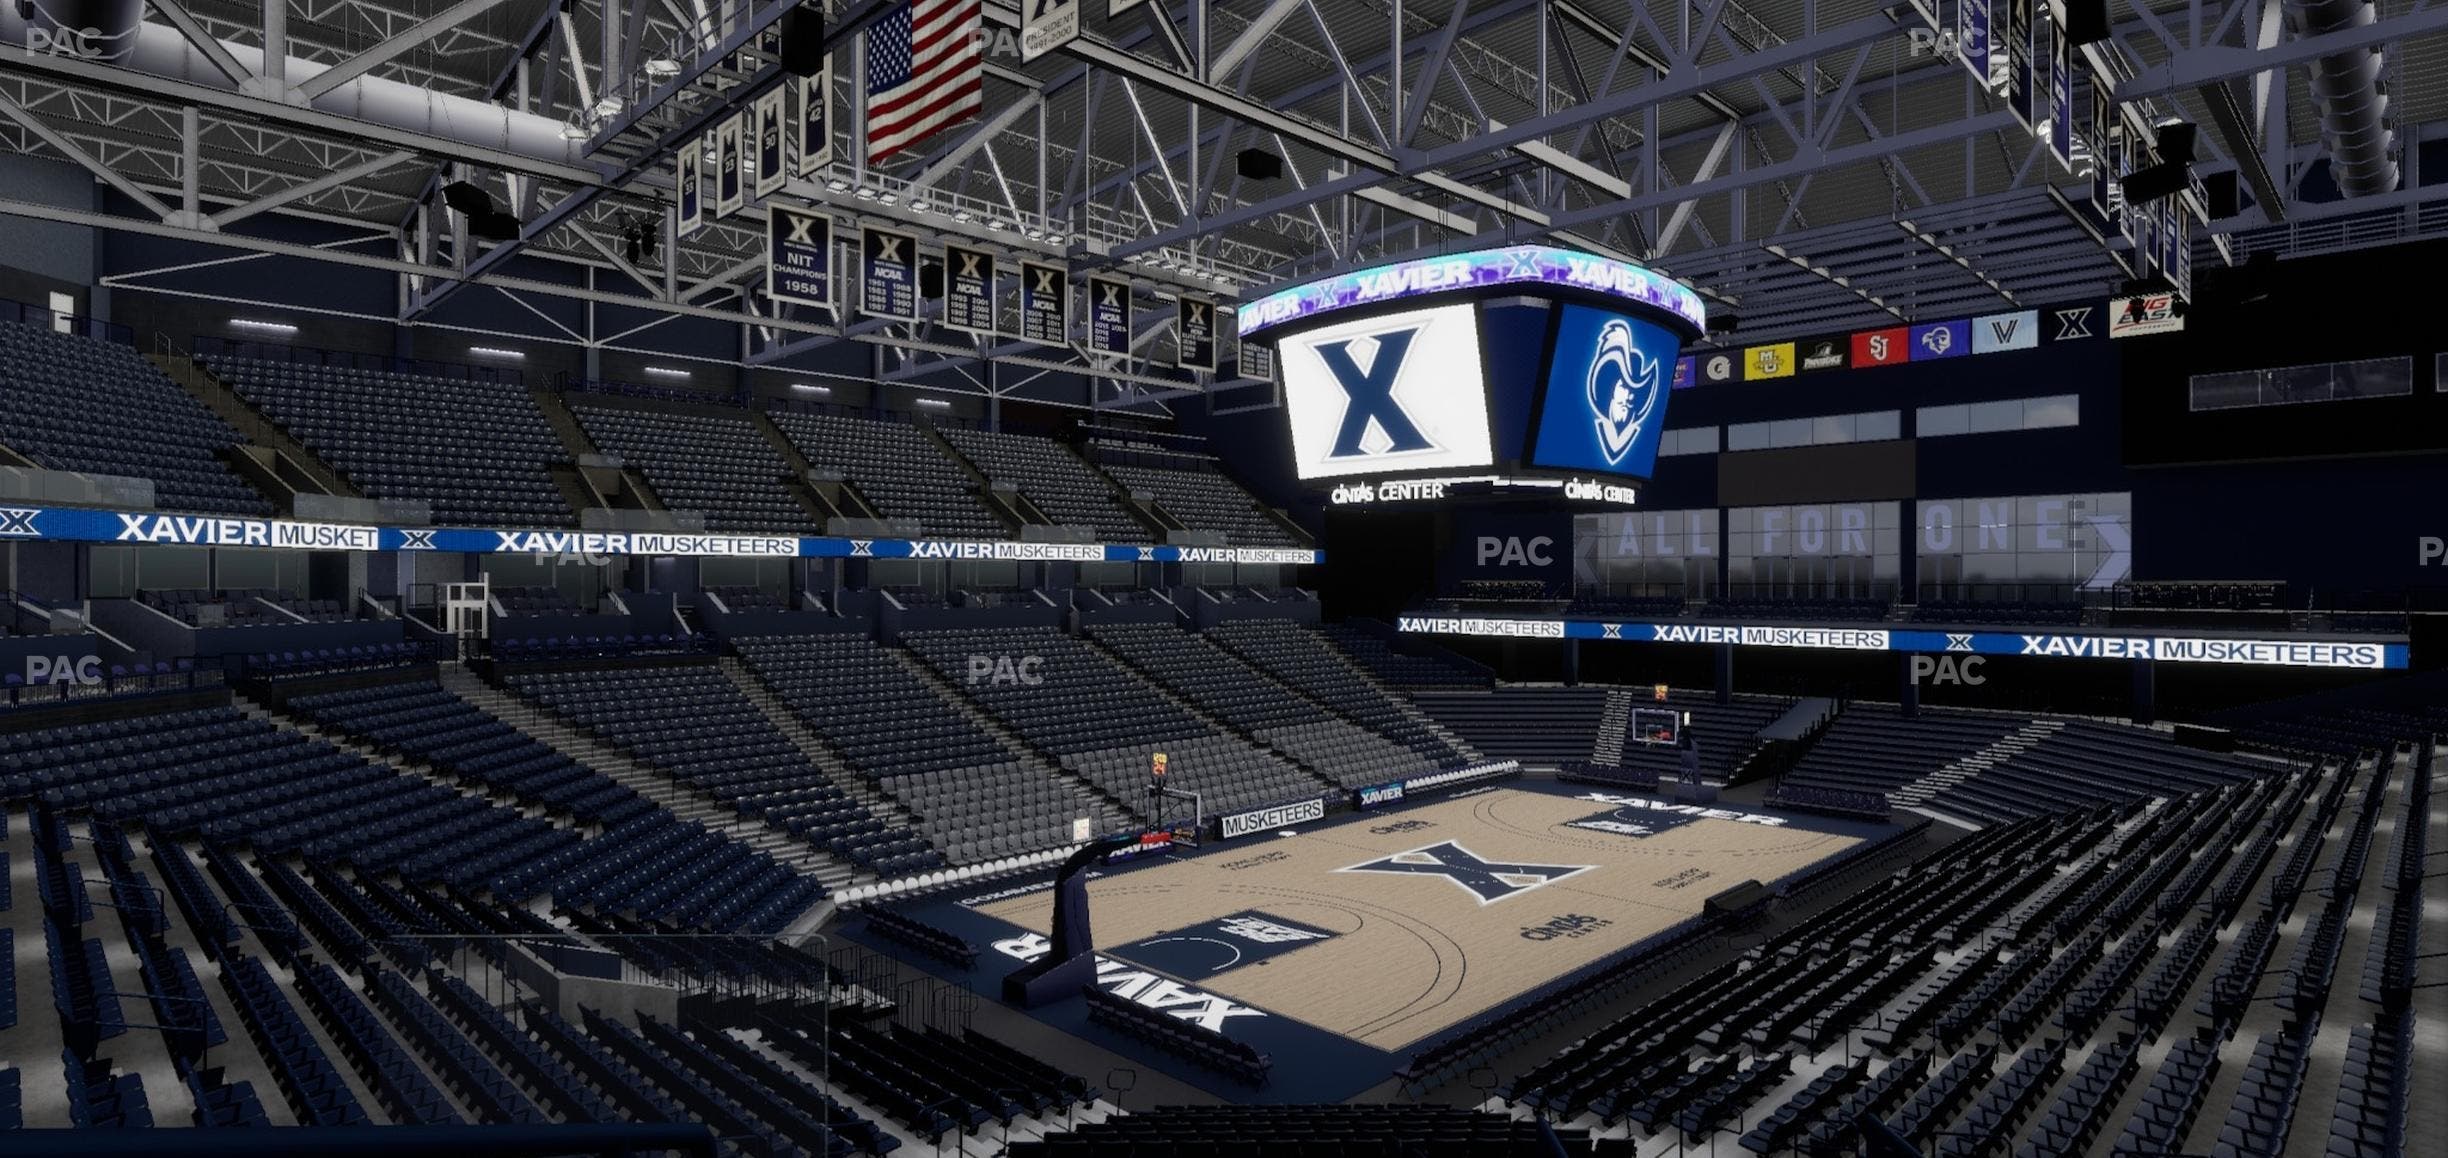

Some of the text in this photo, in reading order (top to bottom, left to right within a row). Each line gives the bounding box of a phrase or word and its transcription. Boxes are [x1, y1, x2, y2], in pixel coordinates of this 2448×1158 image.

[786, 213, 817, 246] X
[773, 263, 827, 280] CHAMPIONS
[787, 252, 814, 268] NIT
[785, 280, 818, 295] 1958
[1356, 261, 1475, 300] XAVIER
[1567, 257, 1649, 298] XAVIER
[2054, 307, 2095, 341] X
[1309, 324, 1446, 461] X
[1379, 484, 1444, 501] CENTER
[117, 513, 268, 547] XAVIER
[279, 524, 377, 548] MUSKET
[495, 531, 628, 554] XAVIER
[638, 535, 795, 555] MUSKETEERS
[909, 541, 993, 559] XAVIER
[999, 544, 1102, 561] MUSKETEERS
[1178, 547, 1236, 563] XAVIER
[1240, 549, 1313, 563] MUSKETEERS
[1617, 500, 2063, 555] ALL FOR ONE
[1399, 618, 1461, 634] XAVIER
[1464, 620, 1561, 637] MUSKETEERS
[1653, 625, 1740, 644] XAVIER
[1747, 628, 1884, 648] MUSKETEERS
[2021, 635, 2151, 659] XAVIER
[2162, 641, 2378, 666] MUSKETEERS
[1361, 787, 1403, 805] XAVIER
[1574, 793, 1788, 826] XAVIER
[1225, 801, 1321, 837] MUSKETEERS
[1328, 839, 1602, 907] X
